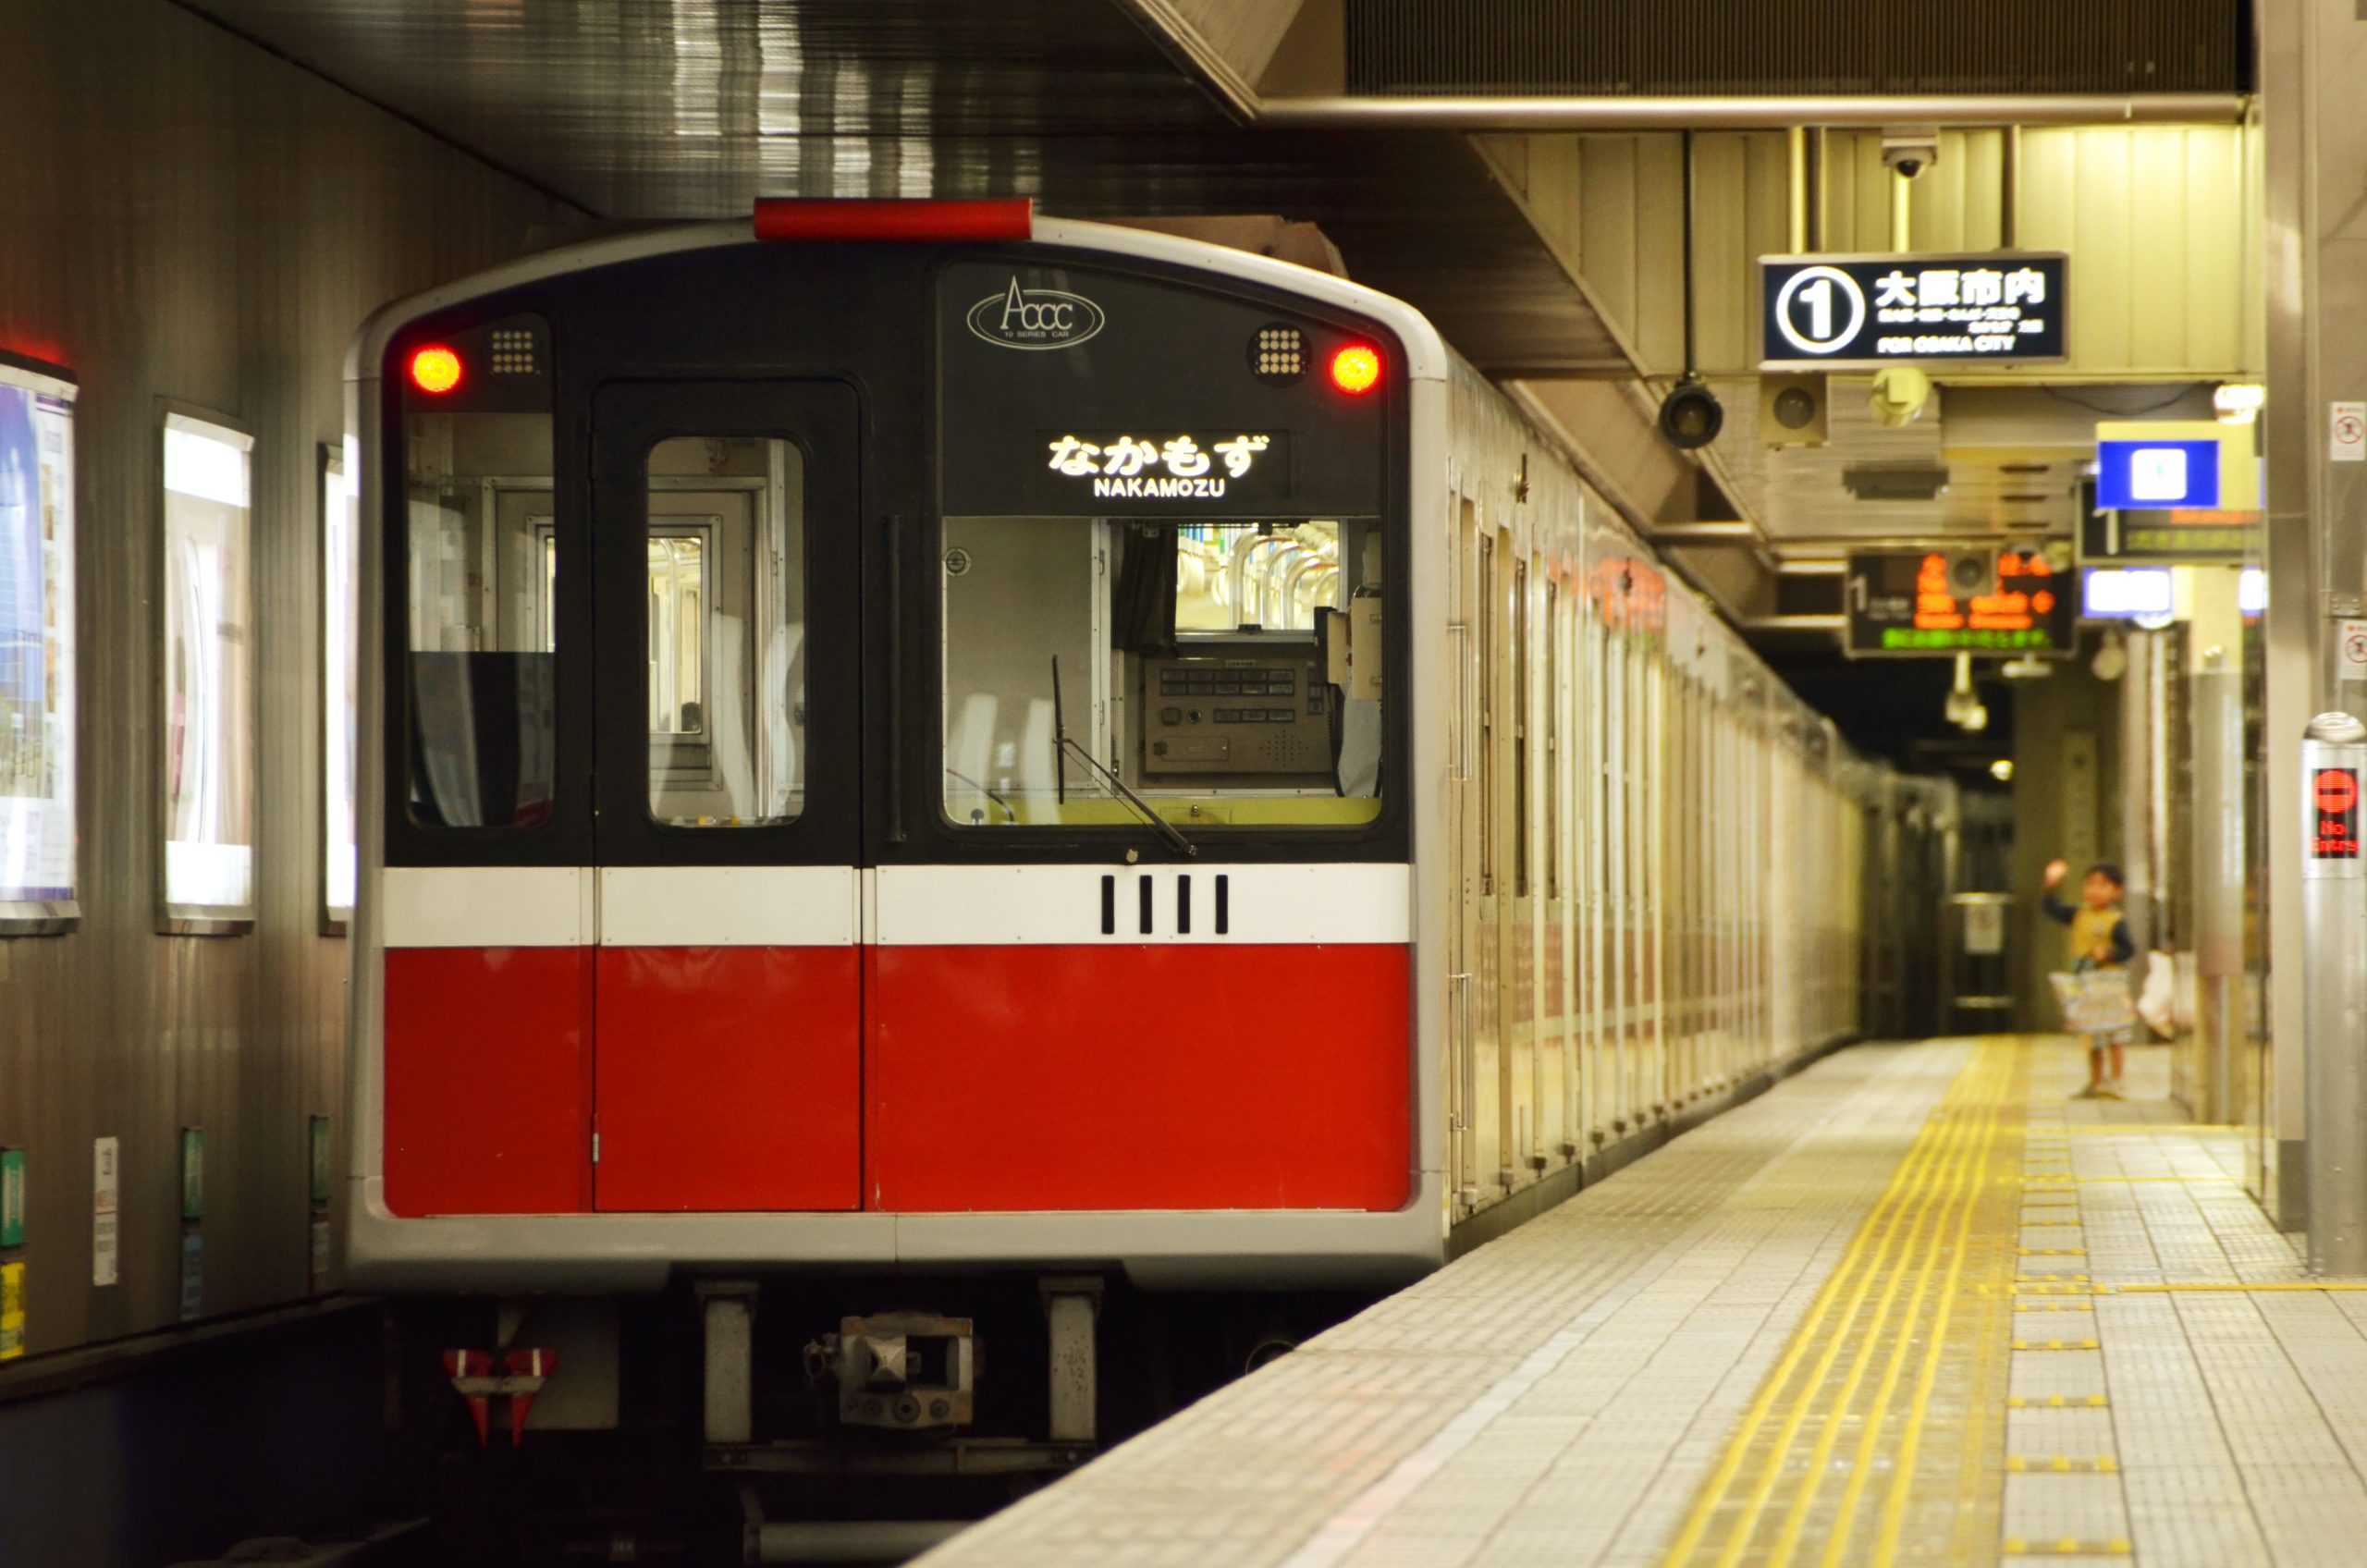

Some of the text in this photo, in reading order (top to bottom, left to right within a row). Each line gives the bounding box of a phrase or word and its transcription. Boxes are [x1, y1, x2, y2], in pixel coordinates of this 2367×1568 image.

[1005, 330, 1070, 338] 10 SERIES CAR
[1913, 336, 1973, 353] OSAKA
[1974, 335, 2016, 351] CITY
[1048, 435, 1270, 477] なかもず
[1094, 478, 1226, 497] NAKAMOZU
[2320, 820, 2348, 836] No
